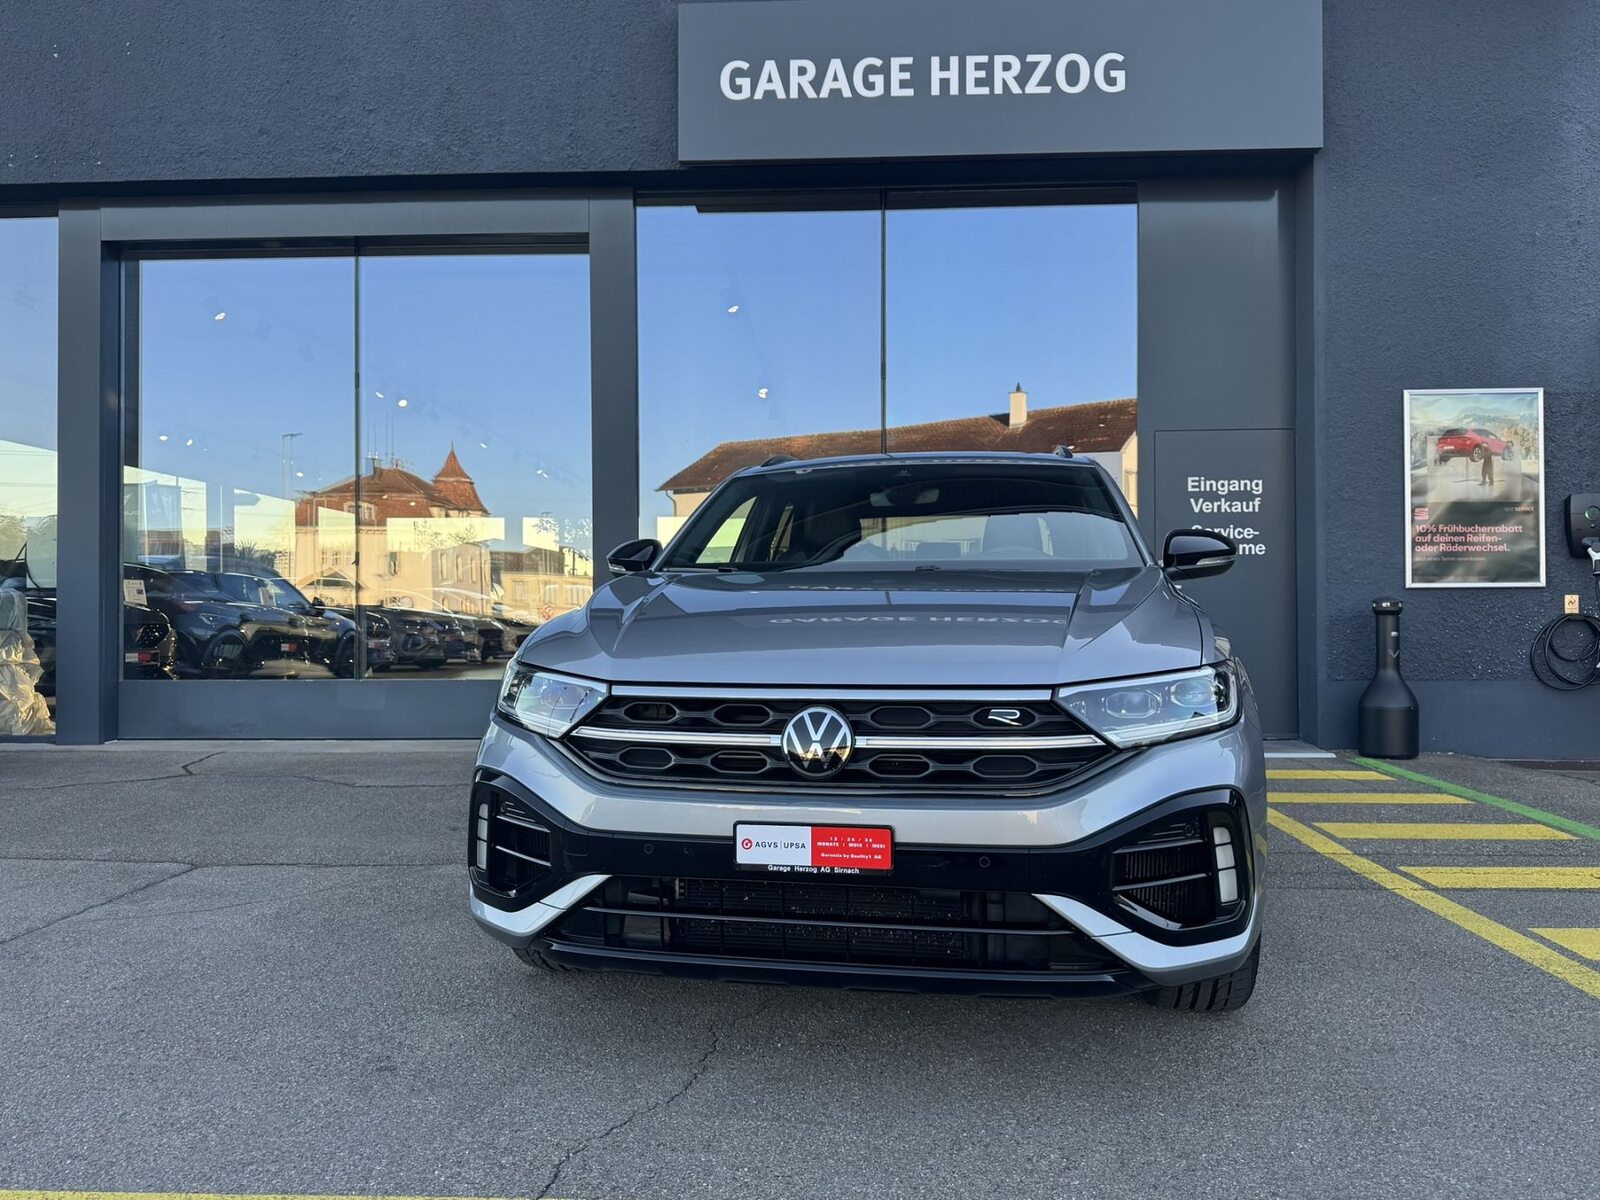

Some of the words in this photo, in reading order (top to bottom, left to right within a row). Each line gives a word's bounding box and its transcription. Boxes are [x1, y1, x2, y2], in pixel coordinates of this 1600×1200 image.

[720, 56, 914, 101] GARAGE
[931, 52, 1126, 96] HERZOG
[1187, 476, 1263, 495] Eingang
[1190, 497, 1261, 513] Verkauf
[1415, 524, 1437, 533] 10%
[1438, 524, 1523, 533] Frühbucherrabatt
[1415, 533, 1432, 543] auf
[1433, 533, 1465, 543] deinen
[1466, 533, 1502, 543] Reifen-
[1415, 543, 1438, 552] oder
[1439, 542, 1510, 552] Räderwechsel.
[755, 841, 778, 849] AGVS
[783, 841, 806, 849] UPSA
[767, 864, 791, 872] Garage
[794, 865, 818, 874] Herzog
[834, 866, 860, 874] Sirnach
